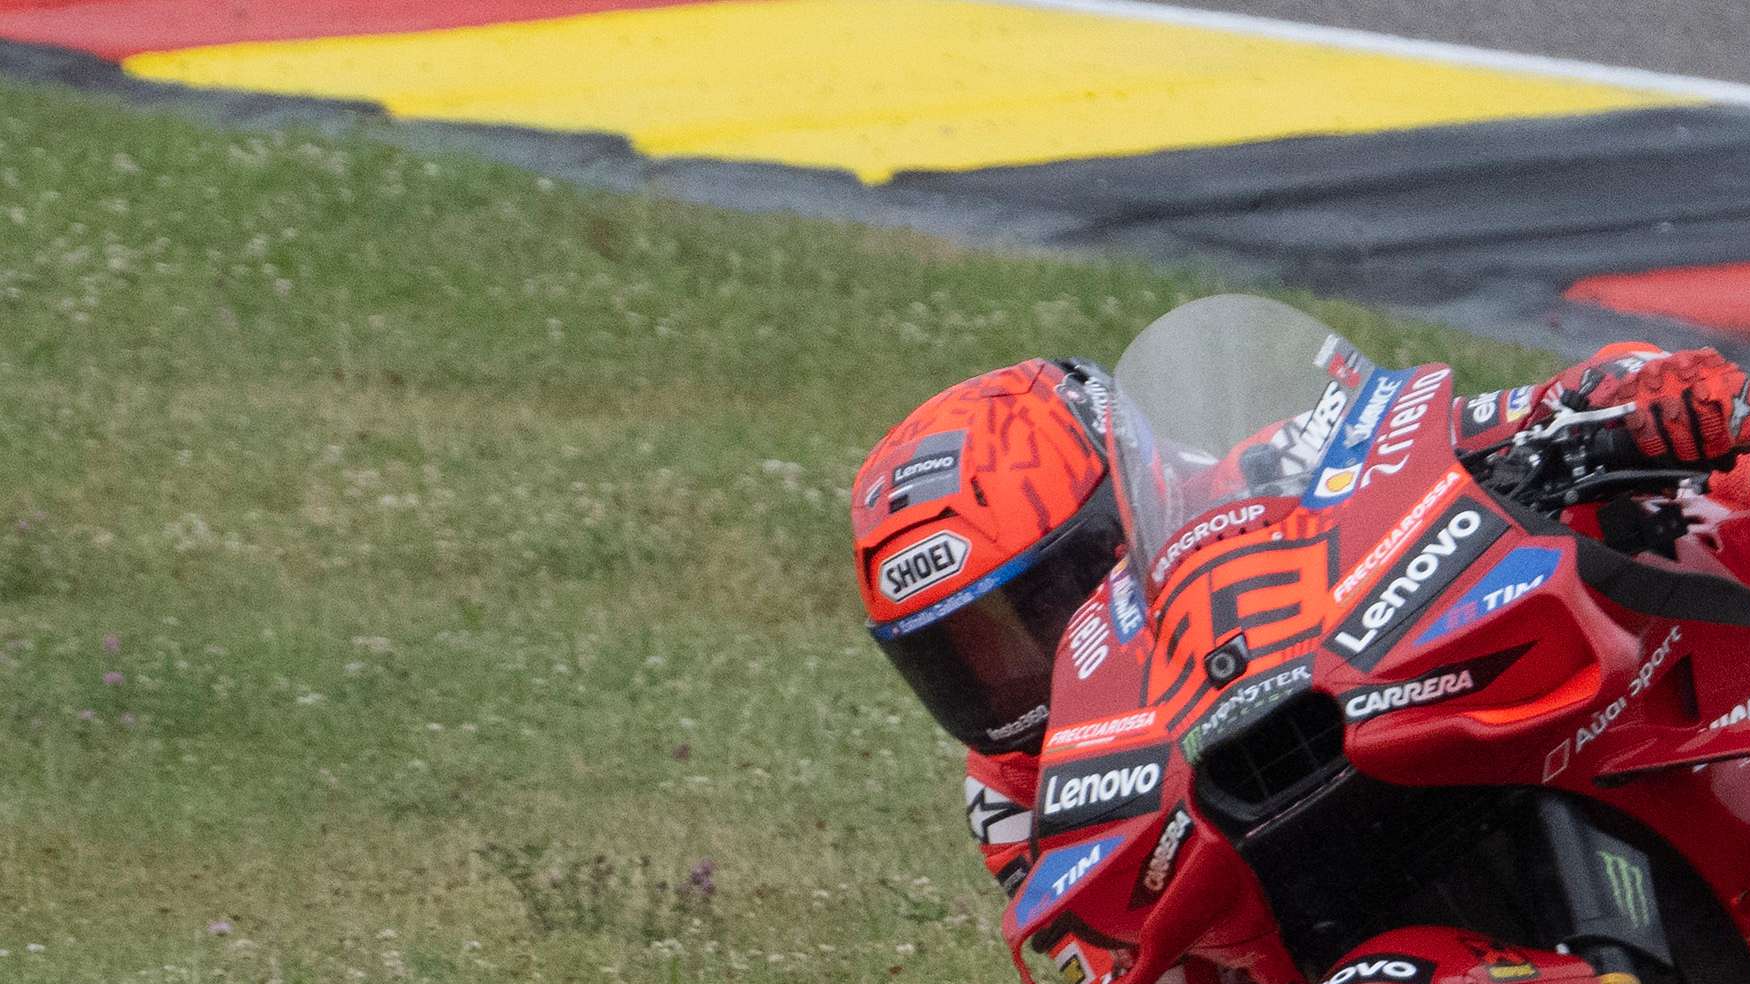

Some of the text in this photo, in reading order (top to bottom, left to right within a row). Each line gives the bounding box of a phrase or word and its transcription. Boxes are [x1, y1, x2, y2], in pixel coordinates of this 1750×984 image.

[1377, 368, 1450, 462] riello
[895, 454, 955, 482] Lenovo
[1334, 470, 1461, 603] FRECCIAROSSA
[886, 541, 955, 593] SHOEI
[1335, 509, 1481, 653] Lenovo
[1483, 574, 1544, 611] TIM
[1199, 665, 1312, 734] MONSTER
[1345, 670, 1475, 718] CARRERA
[1049, 710, 1157, 745] FRECCIAROSSA
[1575, 697, 1628, 753] Audi
[1043, 763, 1161, 815] Lenovo
[1052, 844, 1101, 896] TIM
